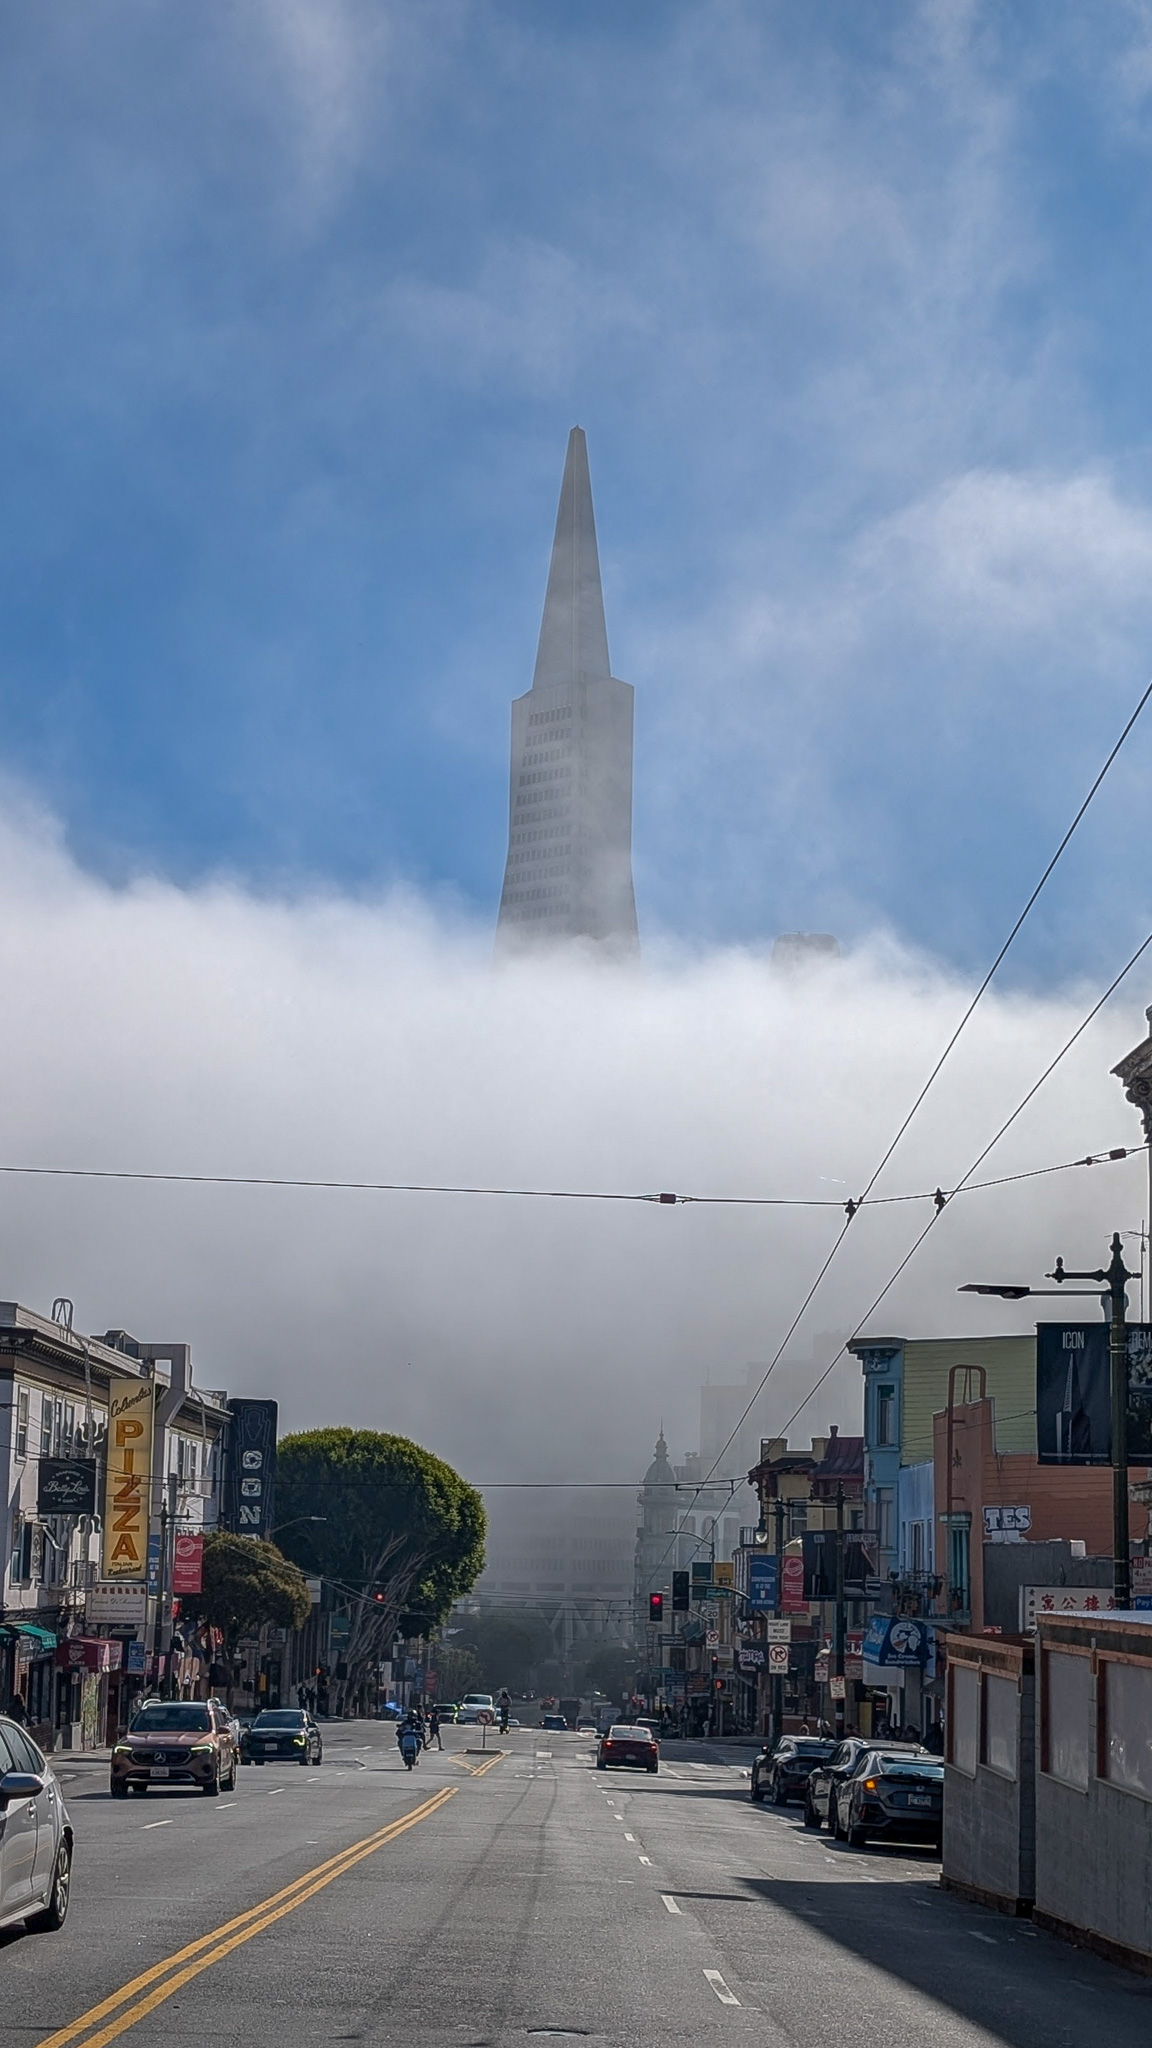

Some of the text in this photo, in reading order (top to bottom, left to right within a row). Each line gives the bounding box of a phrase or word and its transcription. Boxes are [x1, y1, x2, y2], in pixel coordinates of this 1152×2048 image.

[1062, 1331, 1085, 1349] ICON
[111, 1420, 144, 1561] PIZZA
[983, 1505, 1032, 1534] TES
[707, 1610, 718, 1618] 20
